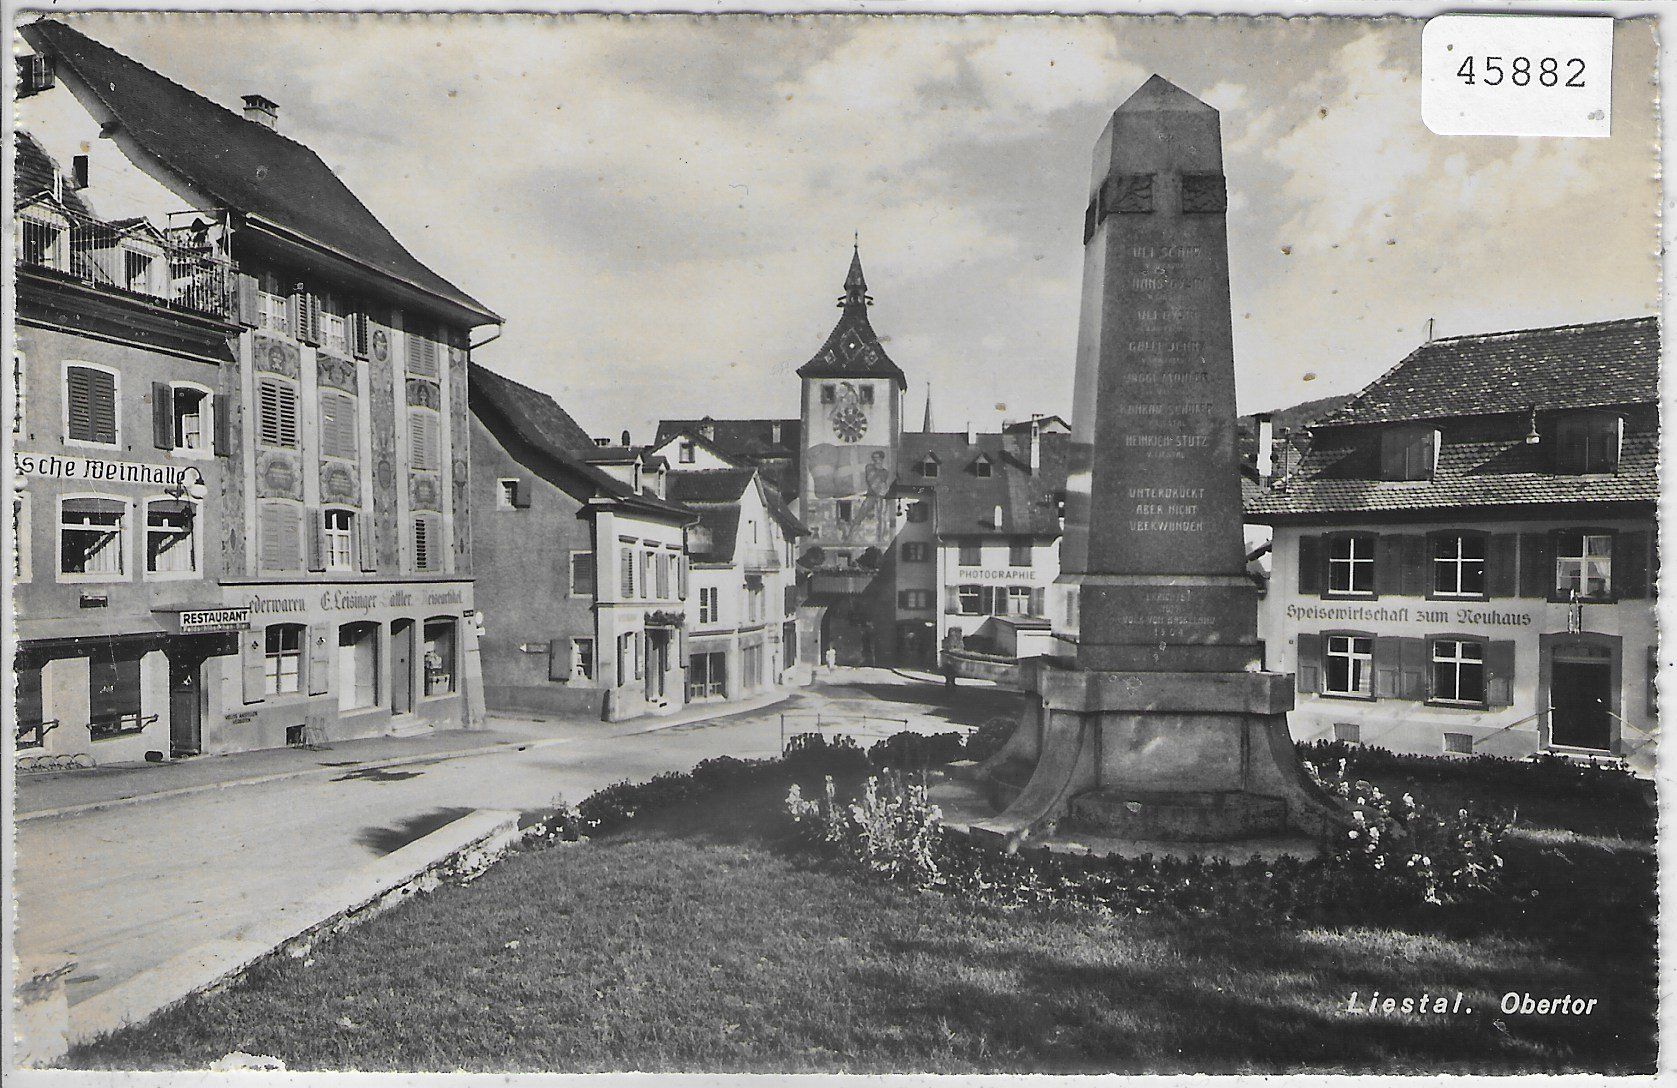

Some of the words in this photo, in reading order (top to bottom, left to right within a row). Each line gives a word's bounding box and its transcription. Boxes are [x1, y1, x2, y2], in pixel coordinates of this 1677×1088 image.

[83, 459, 185, 485] Weinhalle
[1136, 504, 1163, 515] ABER
[1168, 505, 1197, 515] NICHT
[959, 570, 1036, 580] PHOTOGRAPHIE
[183, 610, 248, 624] RESTAURANT
[1286, 604, 1409, 623] Speisewirtschaft
[1416, 608, 1449, 624] zum
[1457, 608, 1532, 626] Neuhaus
